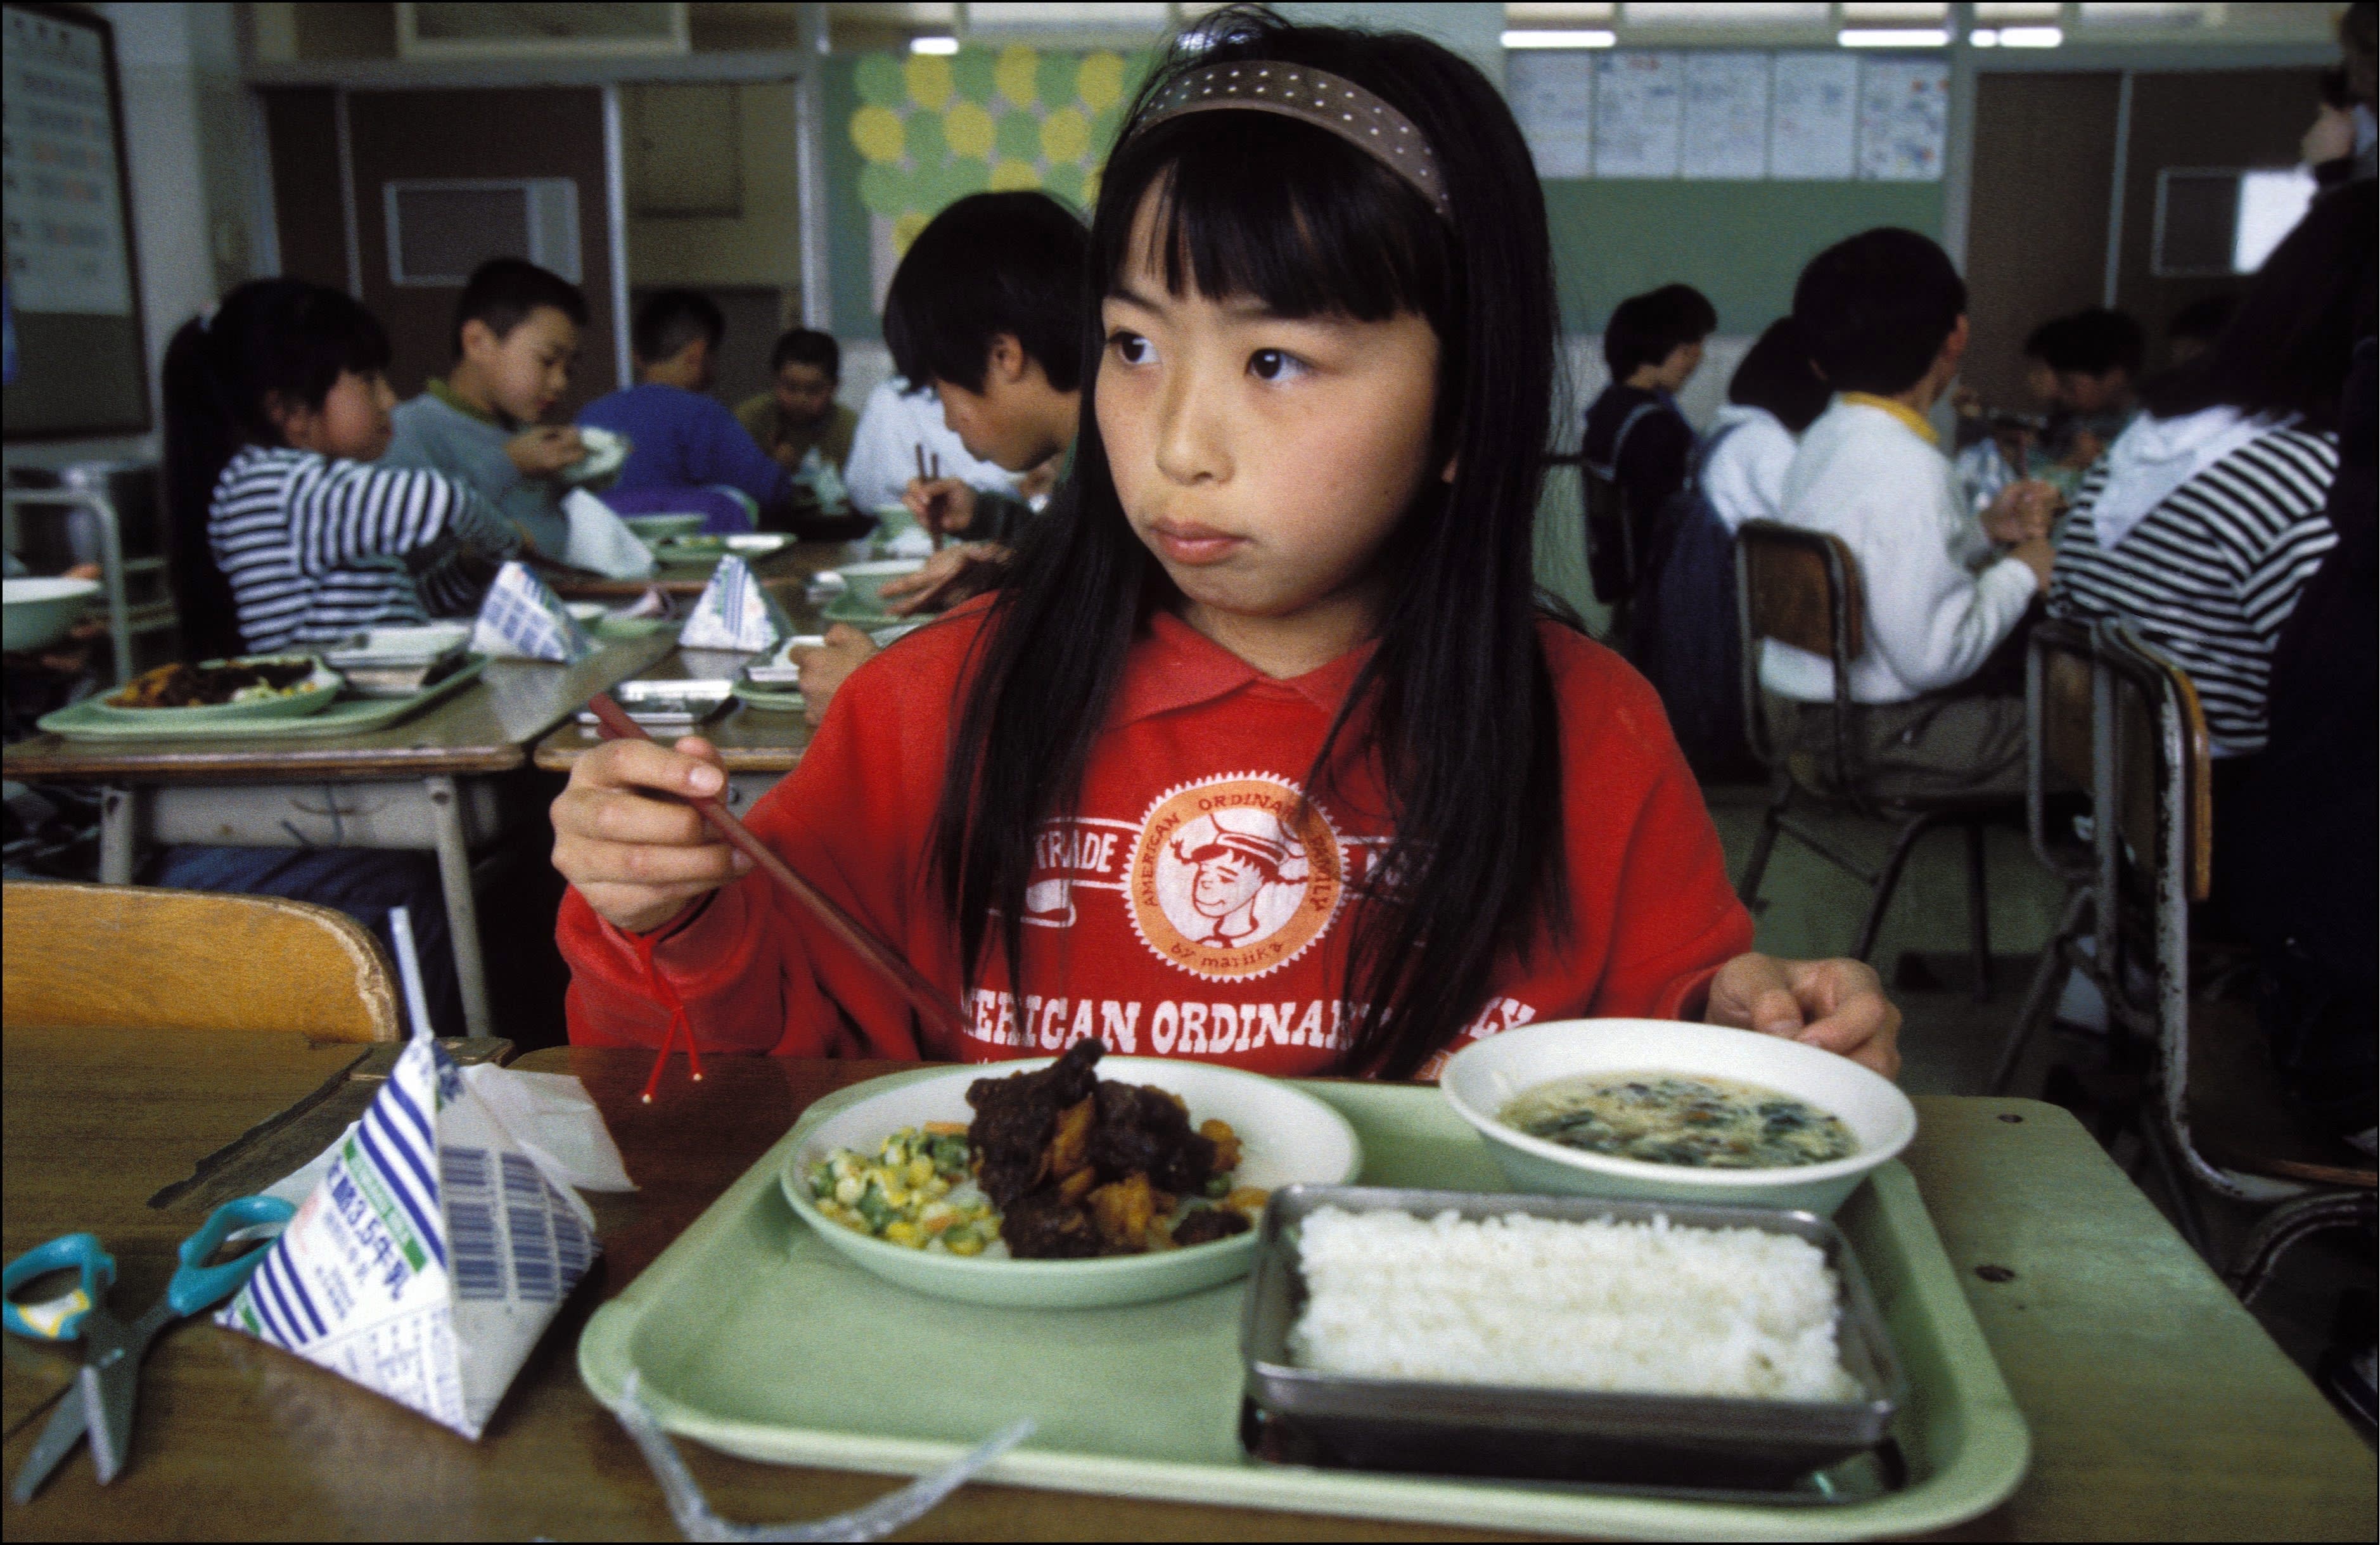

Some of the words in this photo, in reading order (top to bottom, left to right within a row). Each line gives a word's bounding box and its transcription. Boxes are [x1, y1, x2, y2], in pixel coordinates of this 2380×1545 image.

[1035, 829, 1118, 873] TRADE
[1142, 812, 1180, 907] AMERICAN
[1198, 793, 1296, 821] ORDINAR
[961, 987, 1142, 1054] ERICAN
